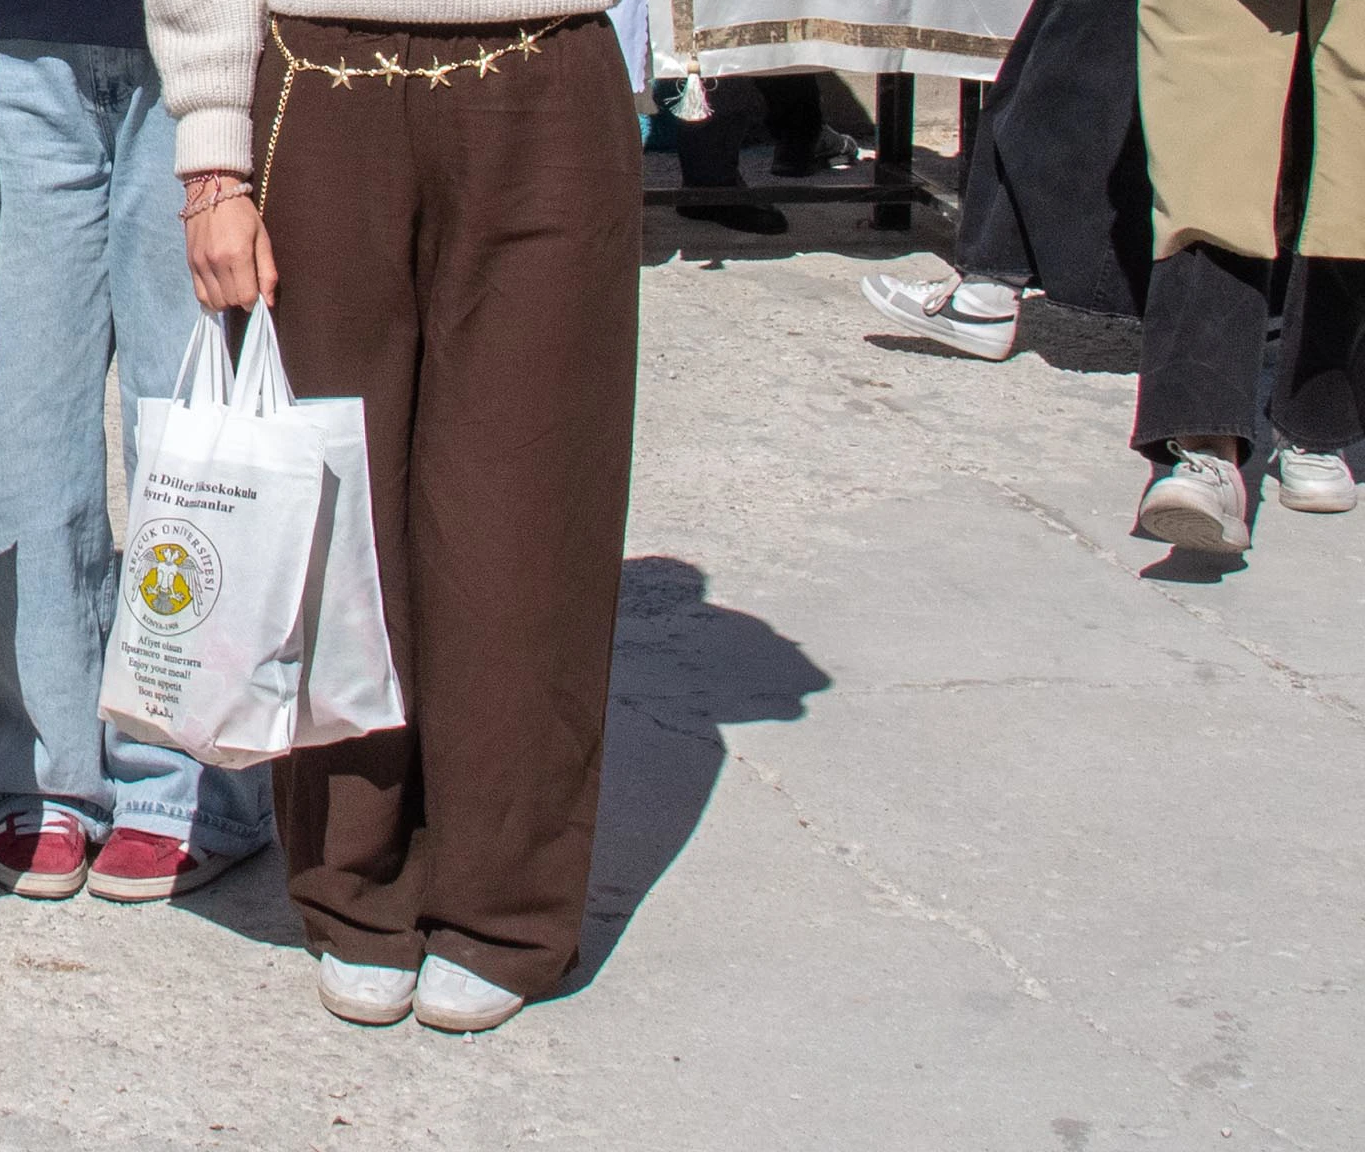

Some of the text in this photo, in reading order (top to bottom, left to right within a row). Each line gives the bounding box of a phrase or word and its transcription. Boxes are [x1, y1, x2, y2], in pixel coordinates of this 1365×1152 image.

[160, 474, 194, 492] Diller
[195, 481, 257, 500] ksekokulu
[175, 495, 235, 513] Raanlar
